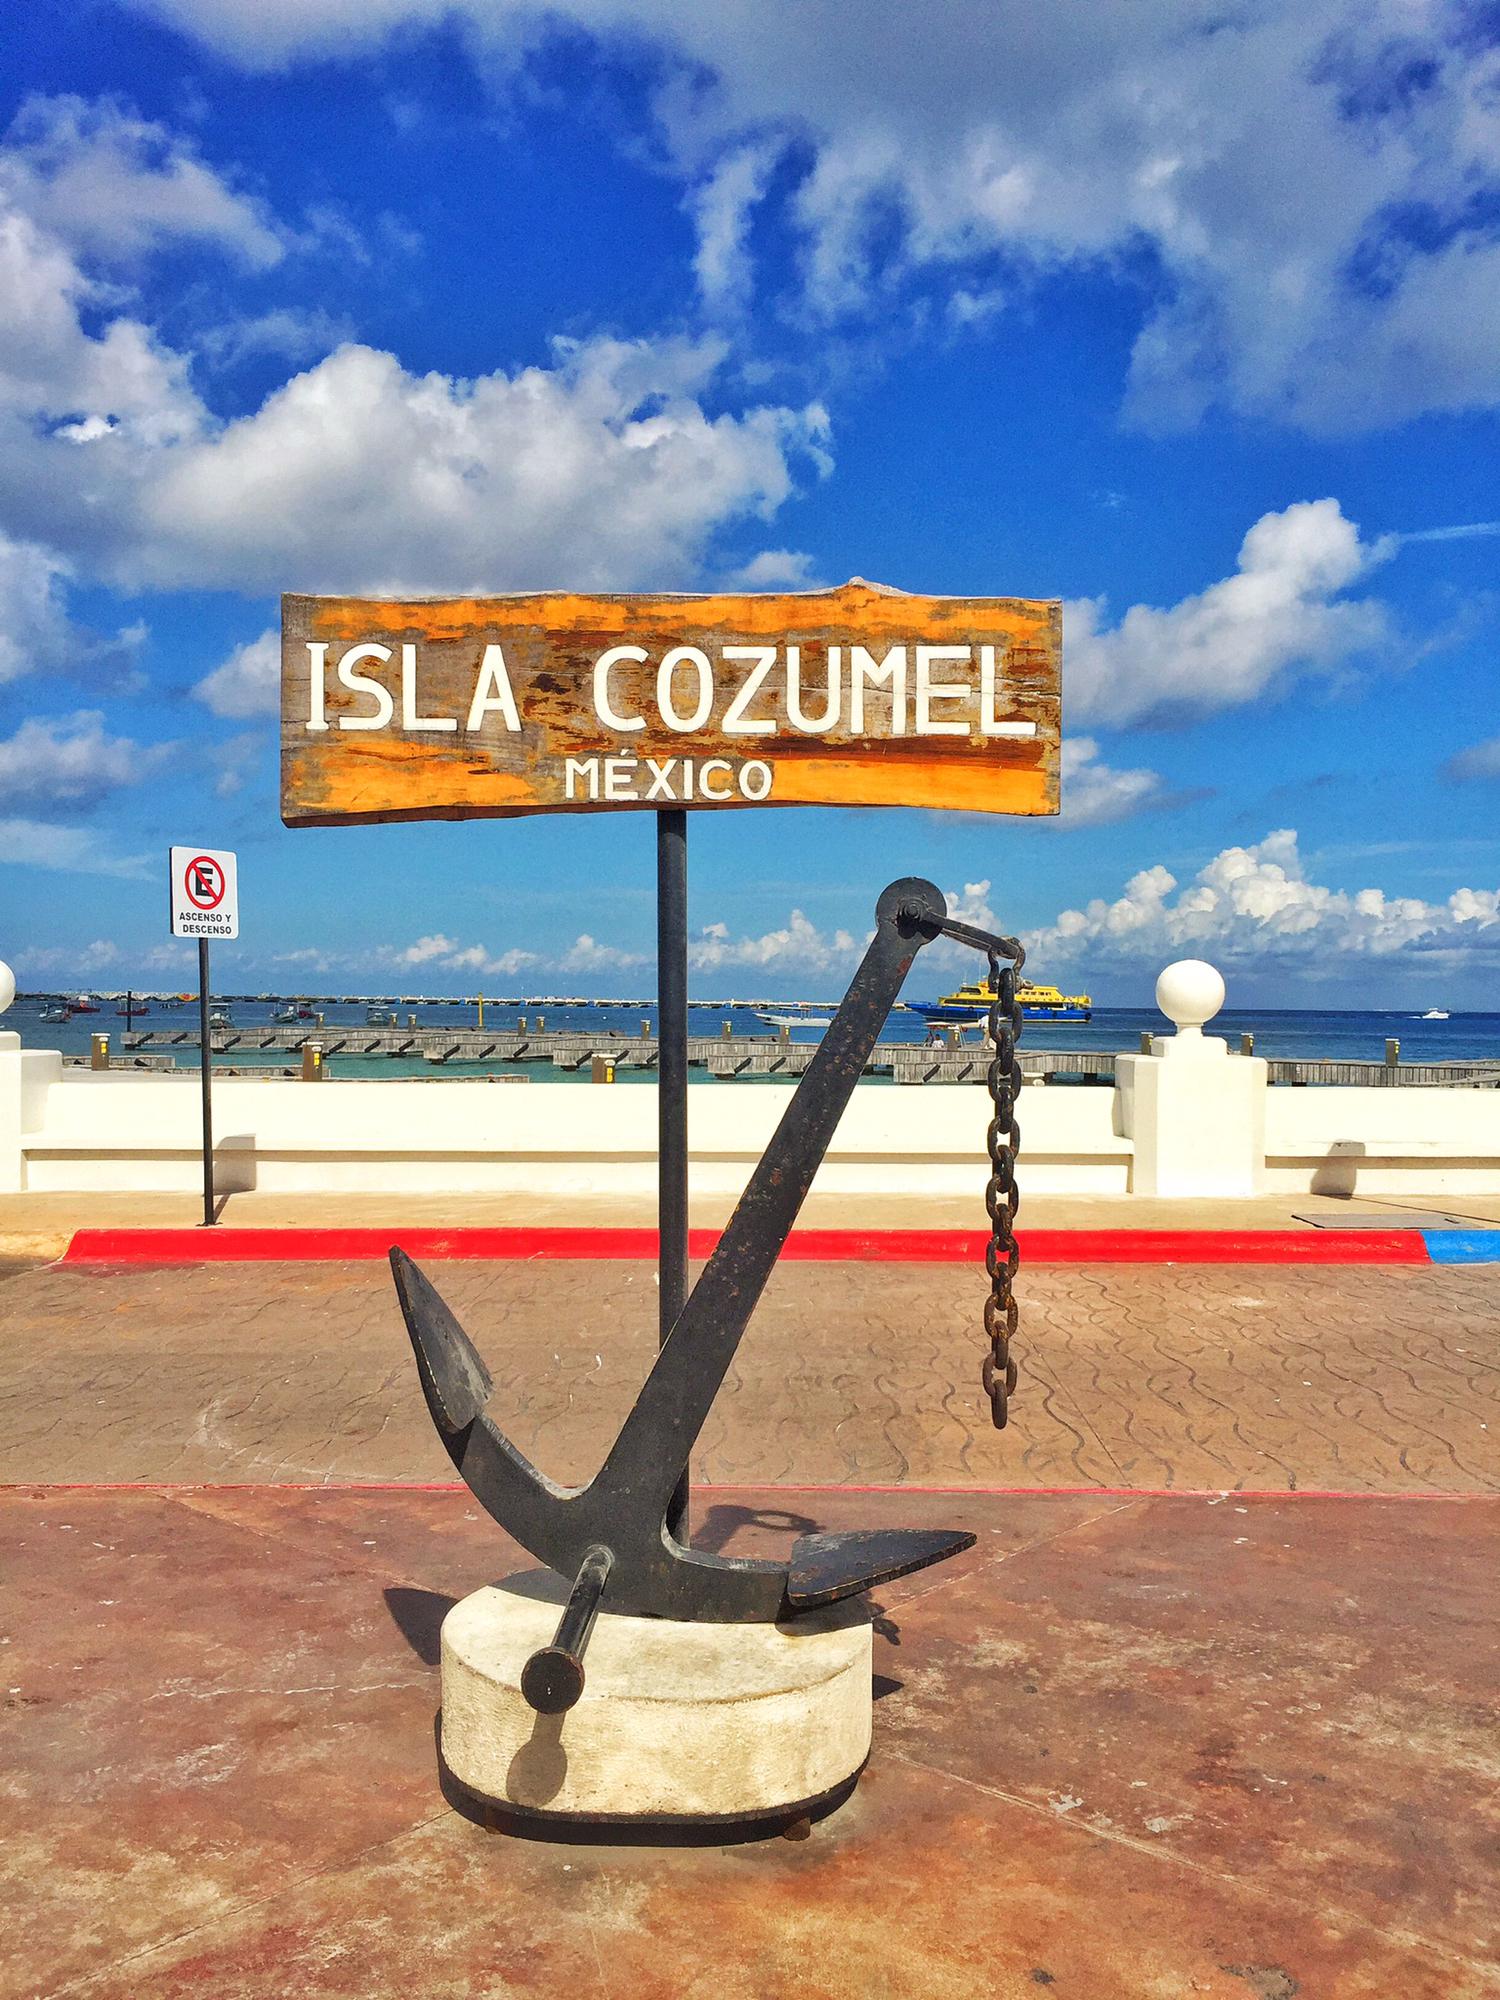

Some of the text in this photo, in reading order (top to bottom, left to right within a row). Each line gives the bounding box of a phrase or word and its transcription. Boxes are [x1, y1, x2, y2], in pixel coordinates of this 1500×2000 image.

[306, 641, 1037, 735] ISLA COZUMEL
[565, 749, 772, 801] MÉXICO
[179, 912, 231, 922] ASCENSO Y
[183, 924, 232, 934] DESCENSO
